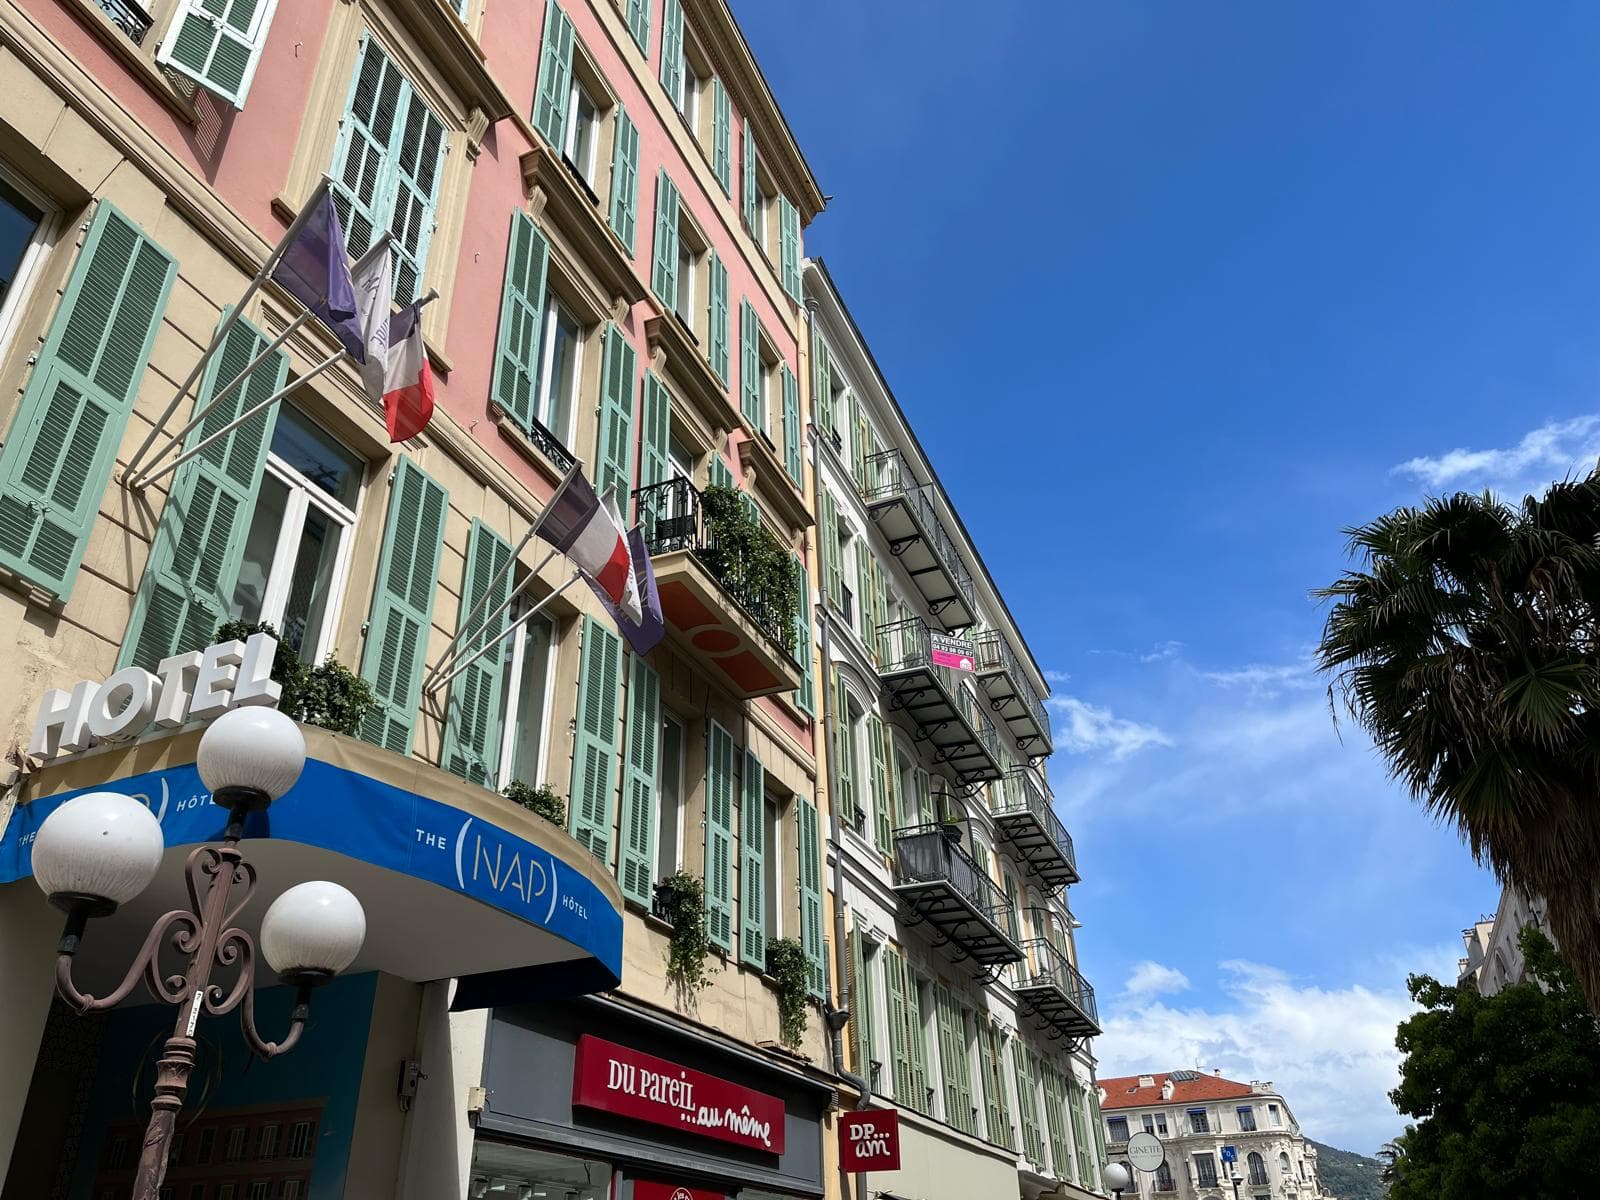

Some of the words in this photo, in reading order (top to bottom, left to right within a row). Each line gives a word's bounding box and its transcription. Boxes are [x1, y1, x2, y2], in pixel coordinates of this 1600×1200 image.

[940, 637, 973, 649] VENDRE
[27, 631, 283, 761] HOTEL
[18, 831, 36, 848] THE
[416, 828, 447, 850] THE
[562, 895, 588, 920] HÔTEL
[607, 1059, 636, 1095] DU
[724, 1104, 772, 1147] même
[855, 1139, 891, 1158] am
